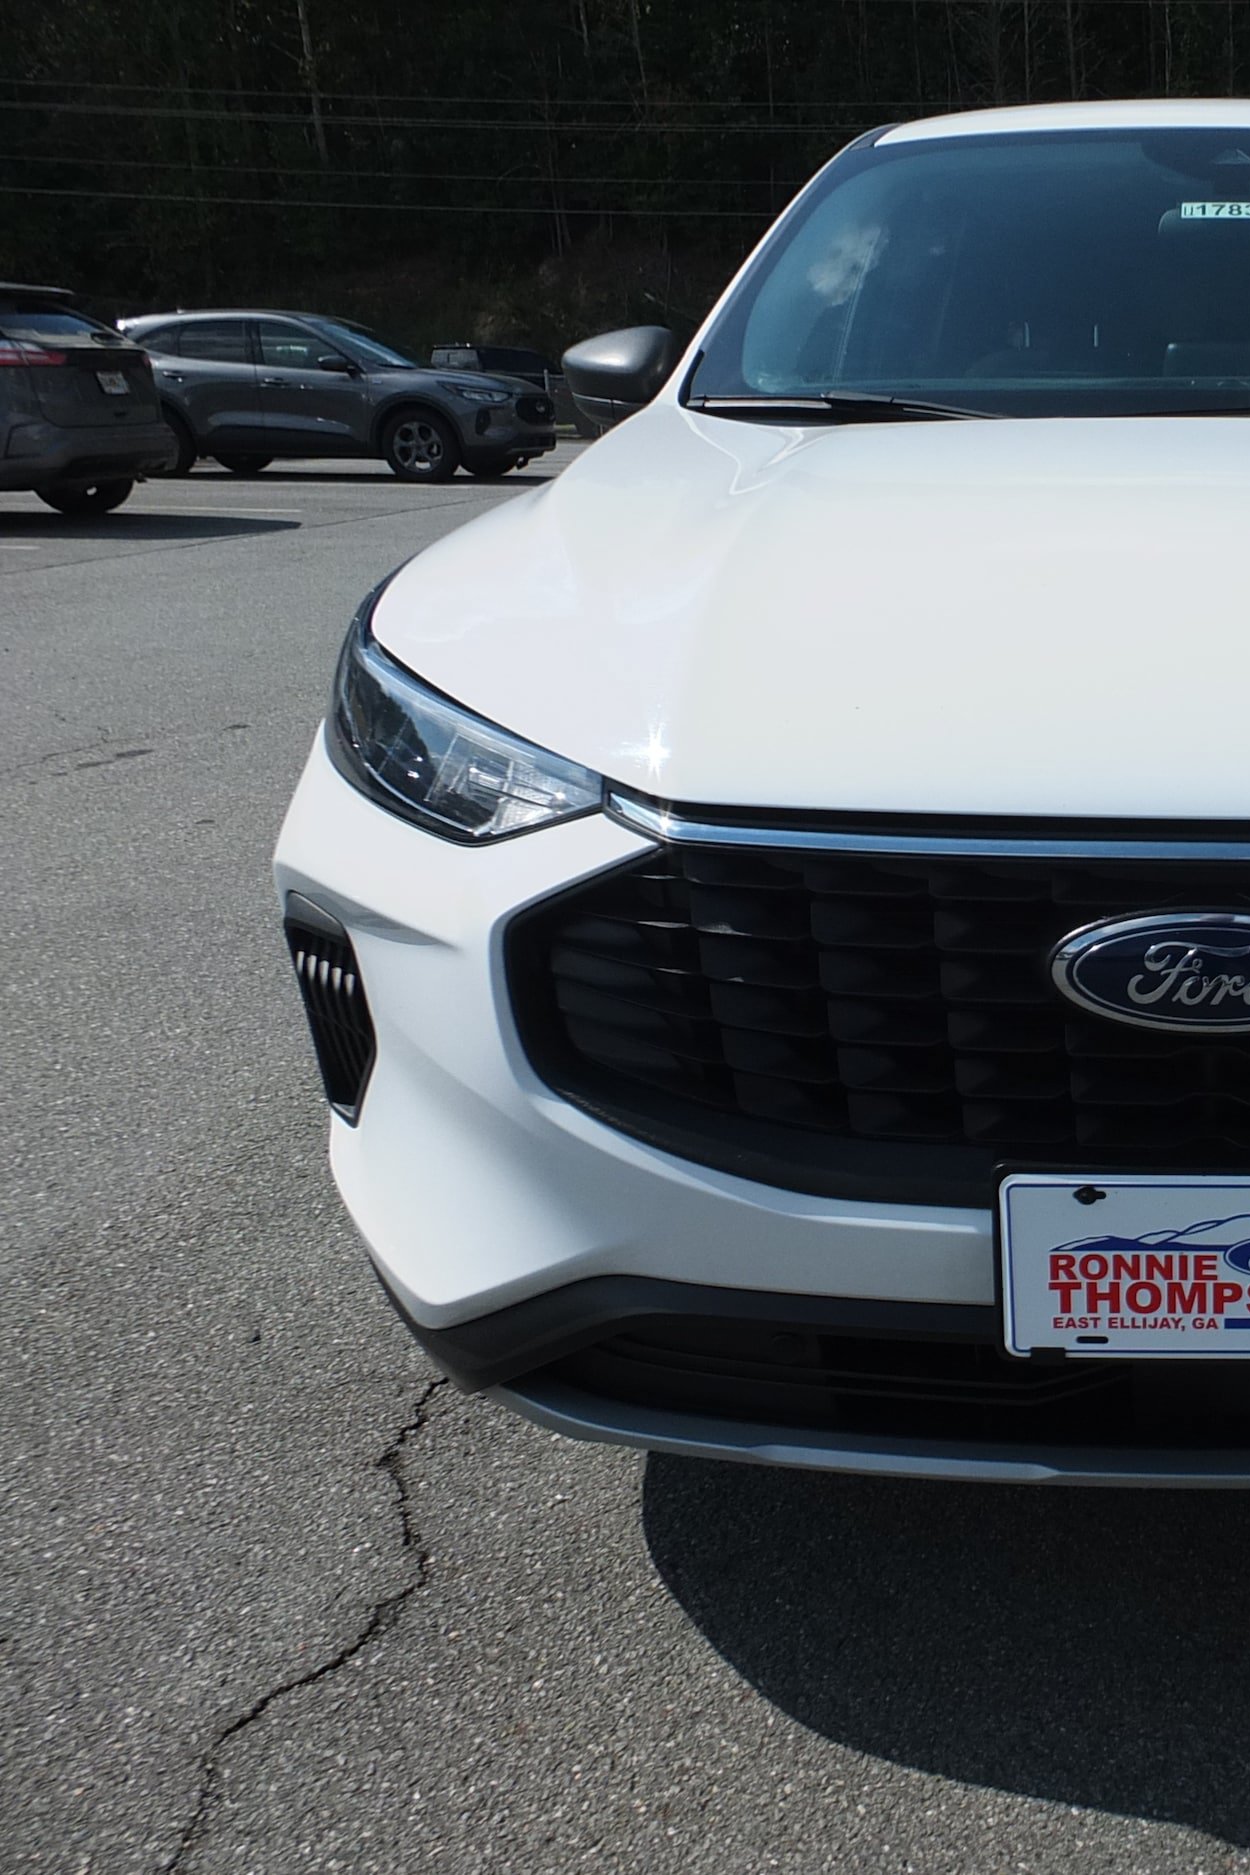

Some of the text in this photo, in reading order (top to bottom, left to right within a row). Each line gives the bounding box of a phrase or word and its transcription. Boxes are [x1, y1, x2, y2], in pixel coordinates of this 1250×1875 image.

[1049, 1254, 1218, 1281] RONNIE
[1053, 1317, 1219, 1332] EAST ELLIJAY, GA
